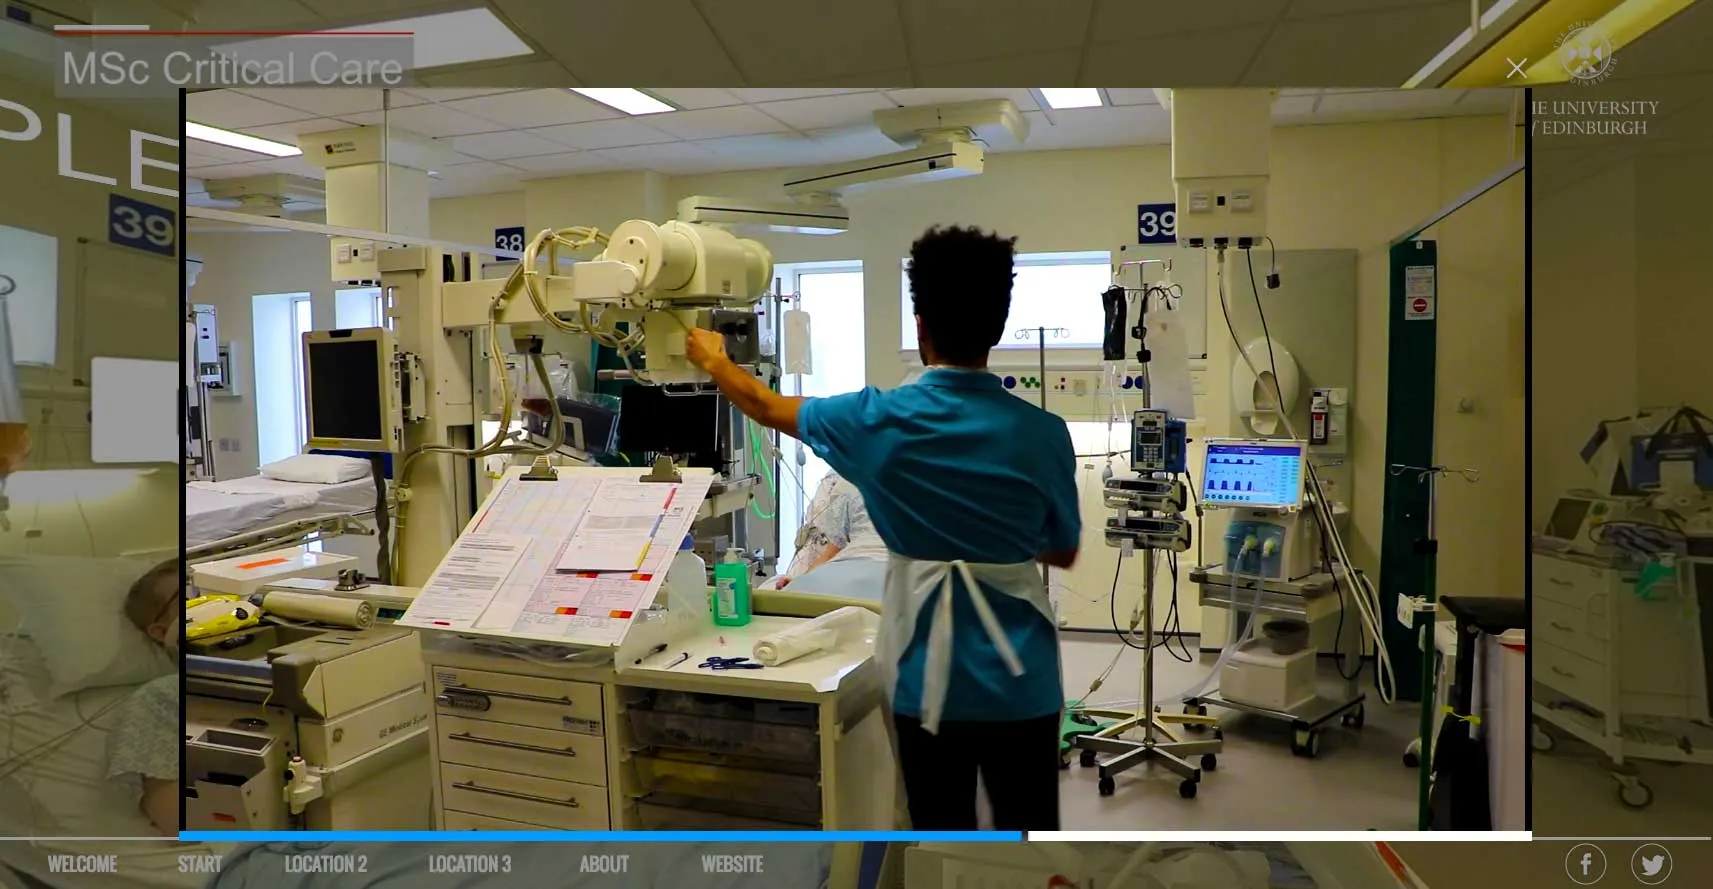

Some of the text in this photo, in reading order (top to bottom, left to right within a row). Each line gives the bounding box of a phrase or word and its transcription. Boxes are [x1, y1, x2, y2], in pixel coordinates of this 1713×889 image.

[112, 205, 175, 247] 39
[1140, 210, 1176, 237] 39
[496, 234, 523, 252] 38
